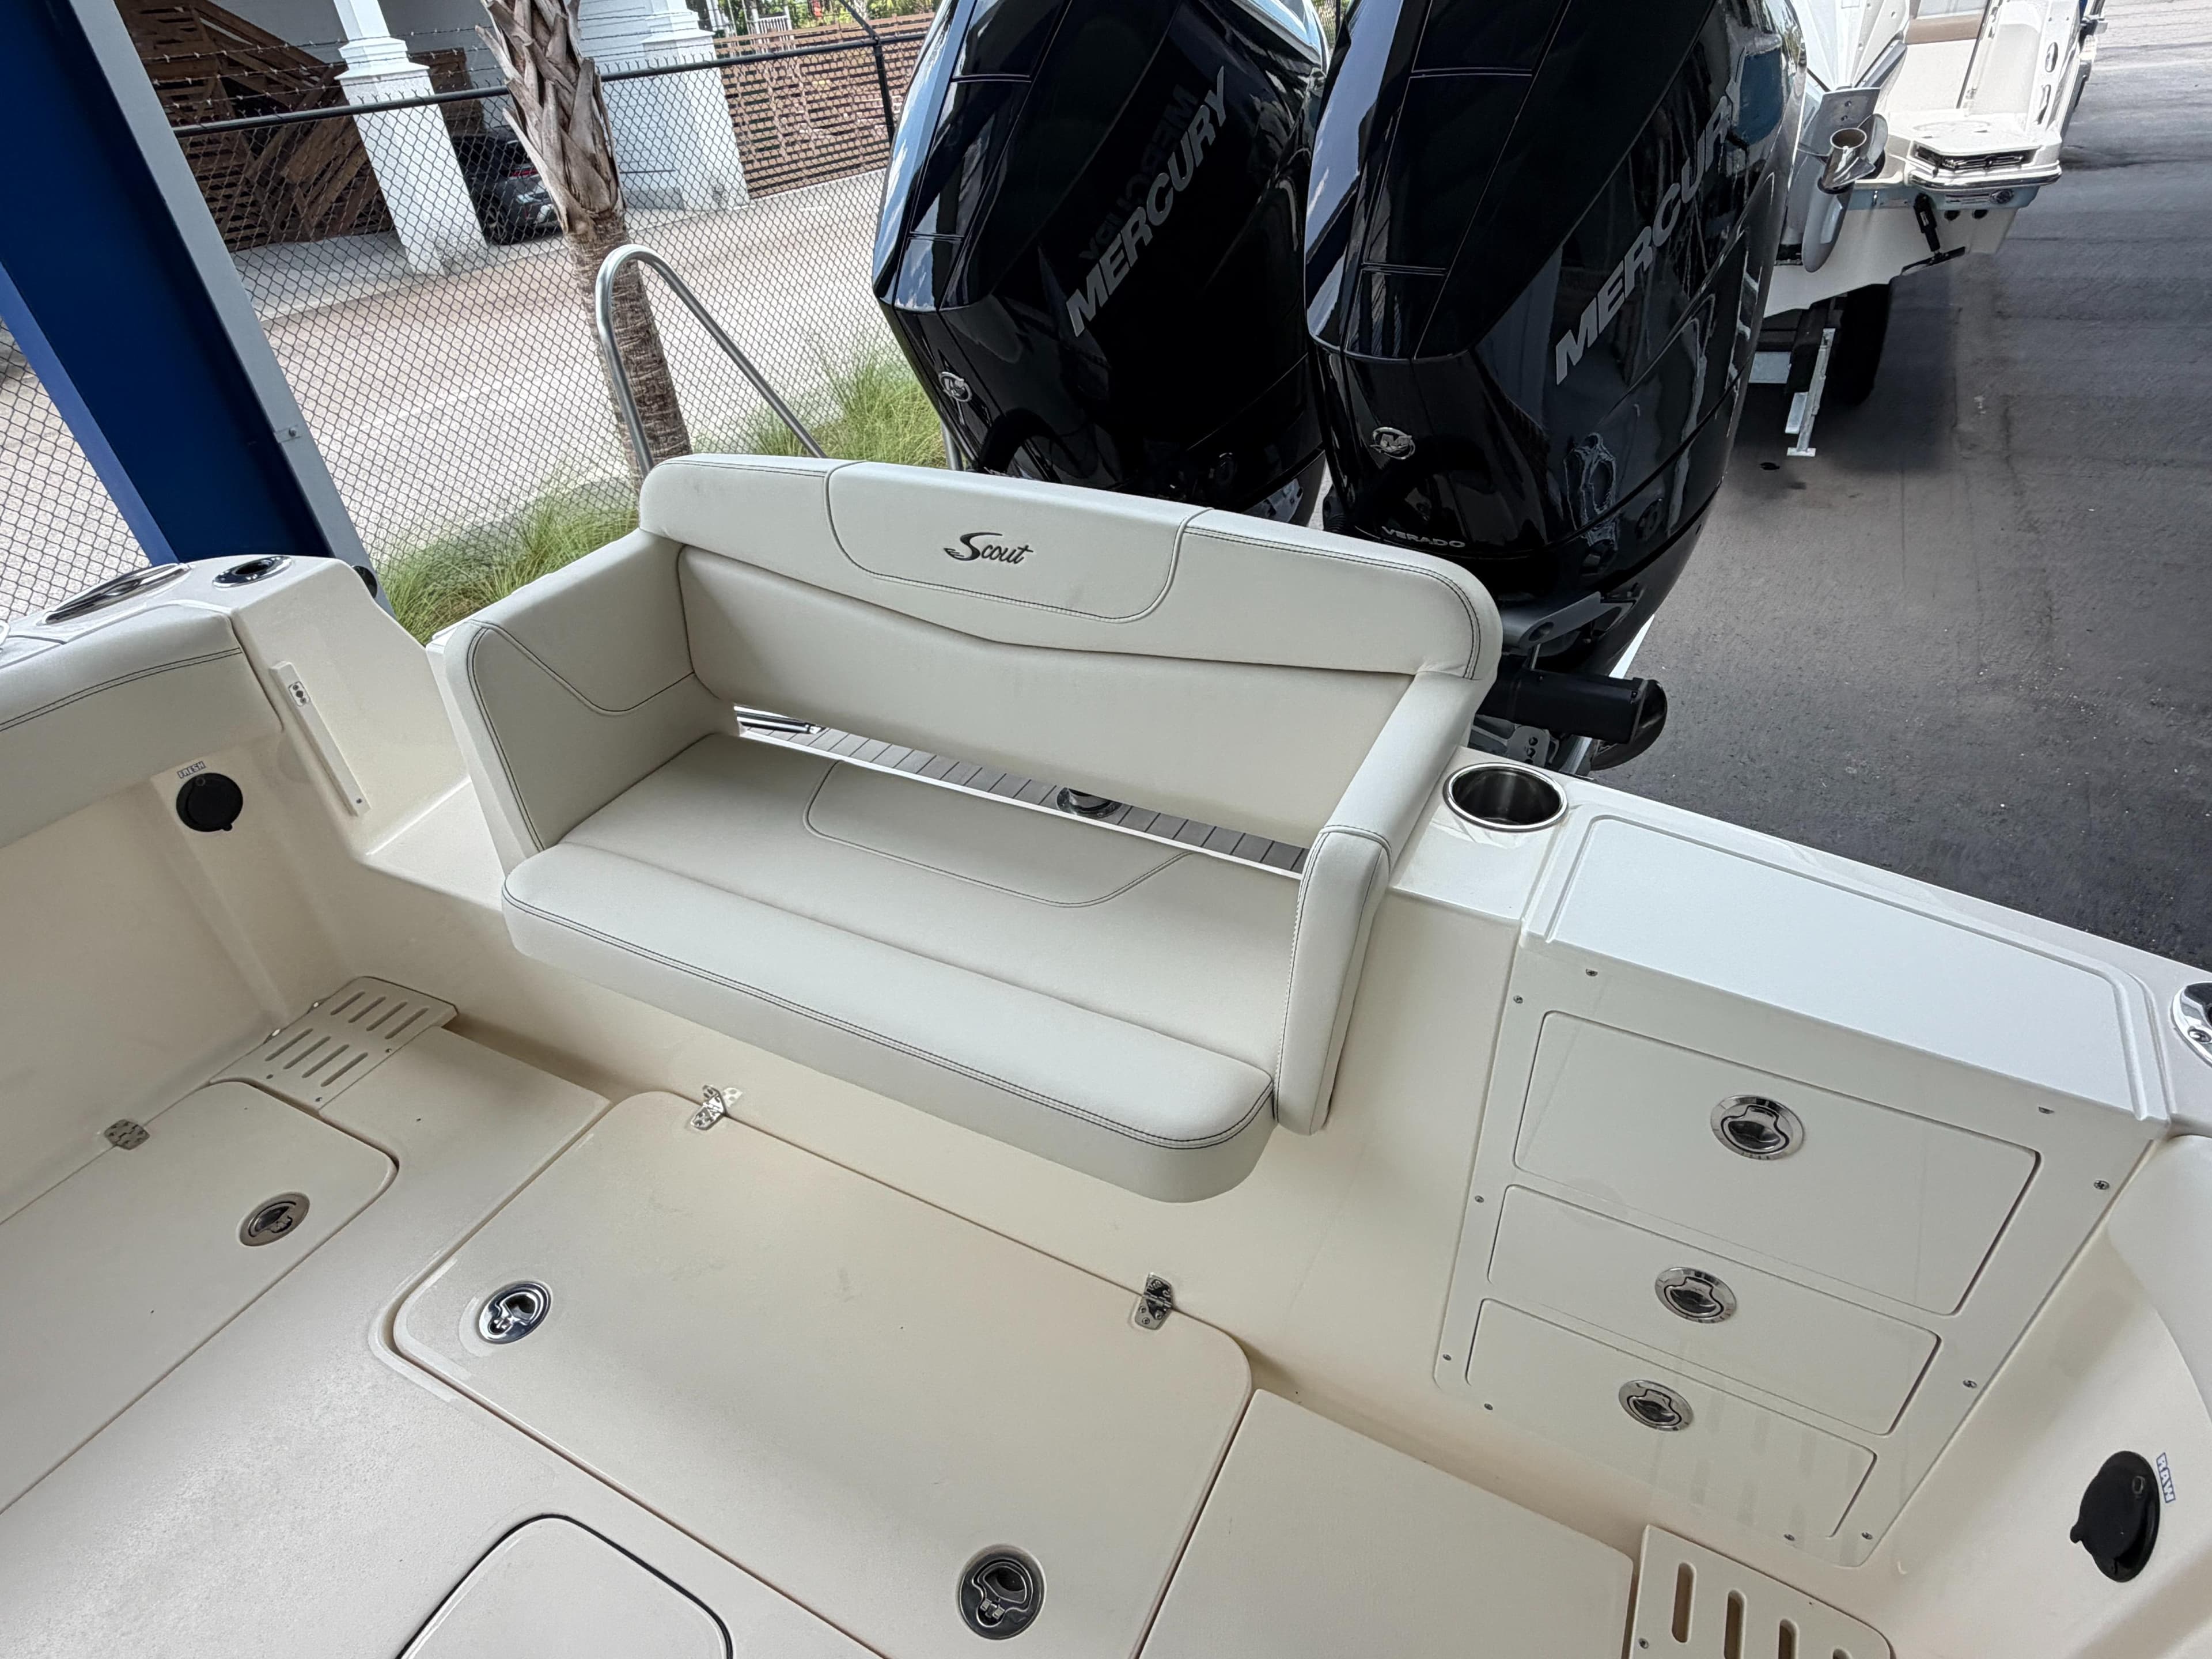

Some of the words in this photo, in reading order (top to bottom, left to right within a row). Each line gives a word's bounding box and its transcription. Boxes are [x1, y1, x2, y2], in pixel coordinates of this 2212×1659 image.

[1066, 66, 1226, 338] MERCURY
[1555, 46, 1747, 385] MERCURY
[943, 532, 1034, 565] Scout
[1381, 526, 1466, 548] VERADO
[177, 761, 206, 779] FRESH
[2156, 1452, 2176, 1503] RAW
